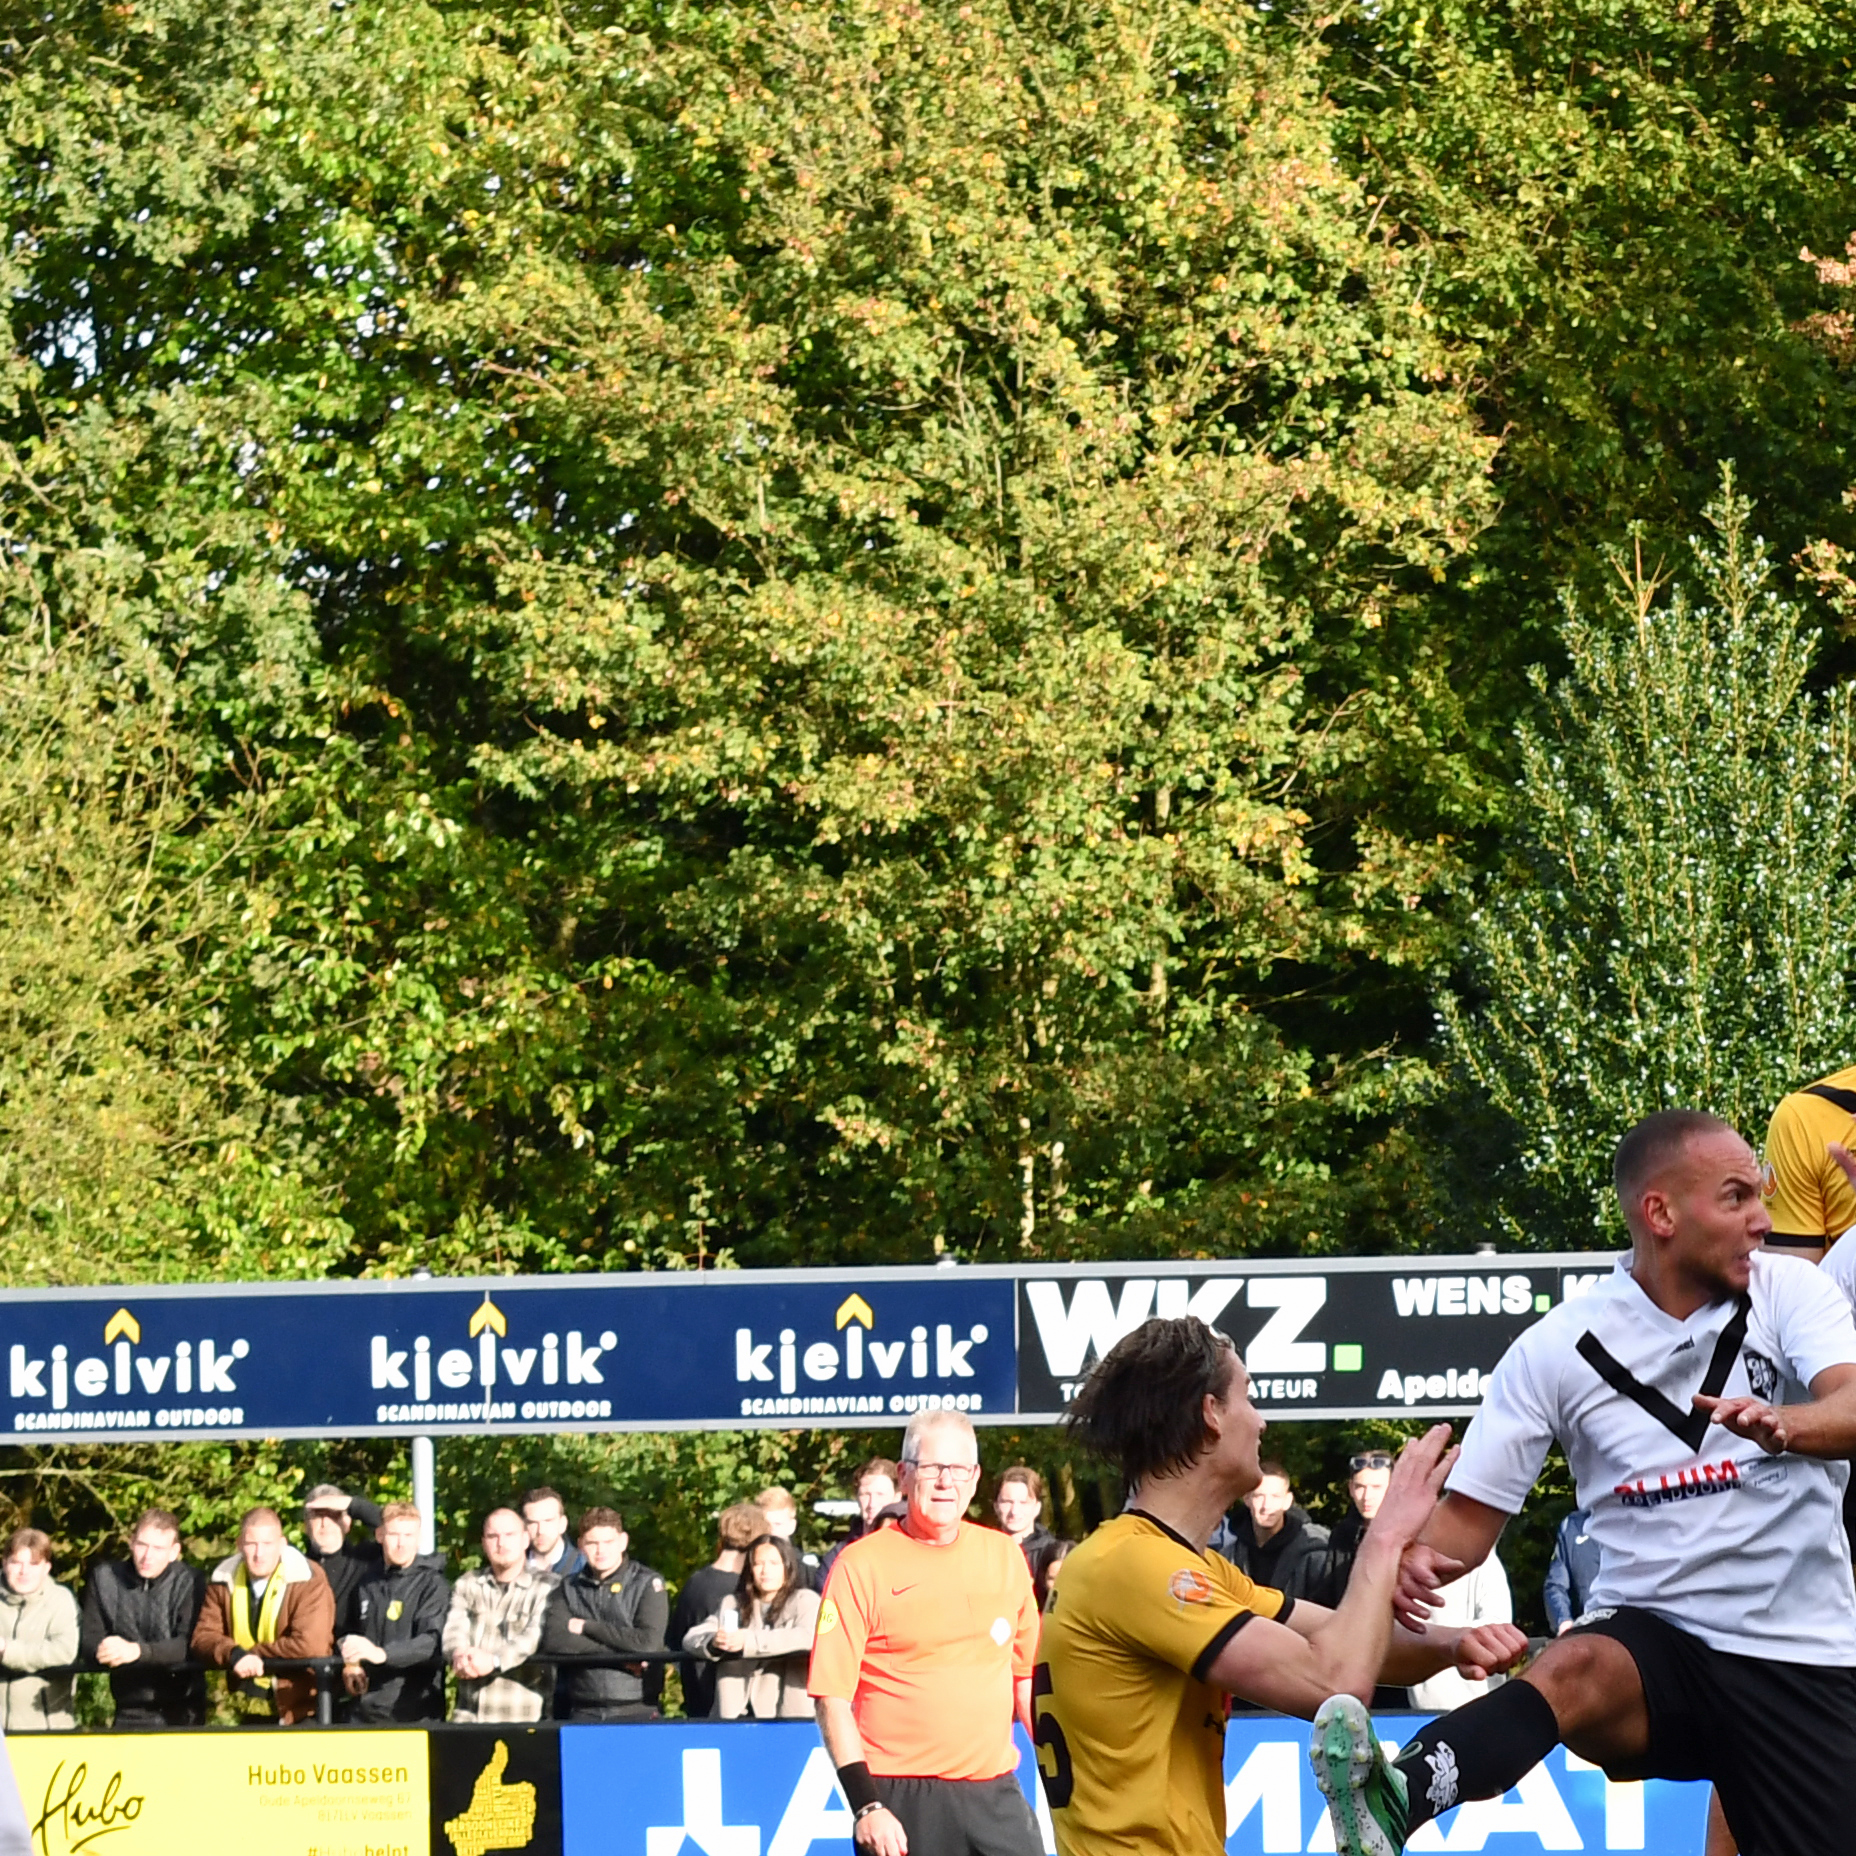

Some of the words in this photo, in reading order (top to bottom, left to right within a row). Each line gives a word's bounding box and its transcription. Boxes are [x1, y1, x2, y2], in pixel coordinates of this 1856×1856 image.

[371, 1330, 604, 1401] kjelvik
[736, 1324, 976, 1395] kjelvik
[10, 1339, 237, 1409] kjelvik
[377, 1402, 516, 1423] SCANDINAVIAN
[521, 1400, 612, 1419] OUTDOOR
[741, 1395, 884, 1416] SCANDINAVIAN
[889, 1393, 983, 1413] OUTDOOR
[14, 1410, 150, 1431] SCANDINAVIAN
[155, 1407, 244, 1428] OUTDOOR
[248, 1764, 306, 1785] Hubo
[312, 1763, 408, 1784] Vaassen
